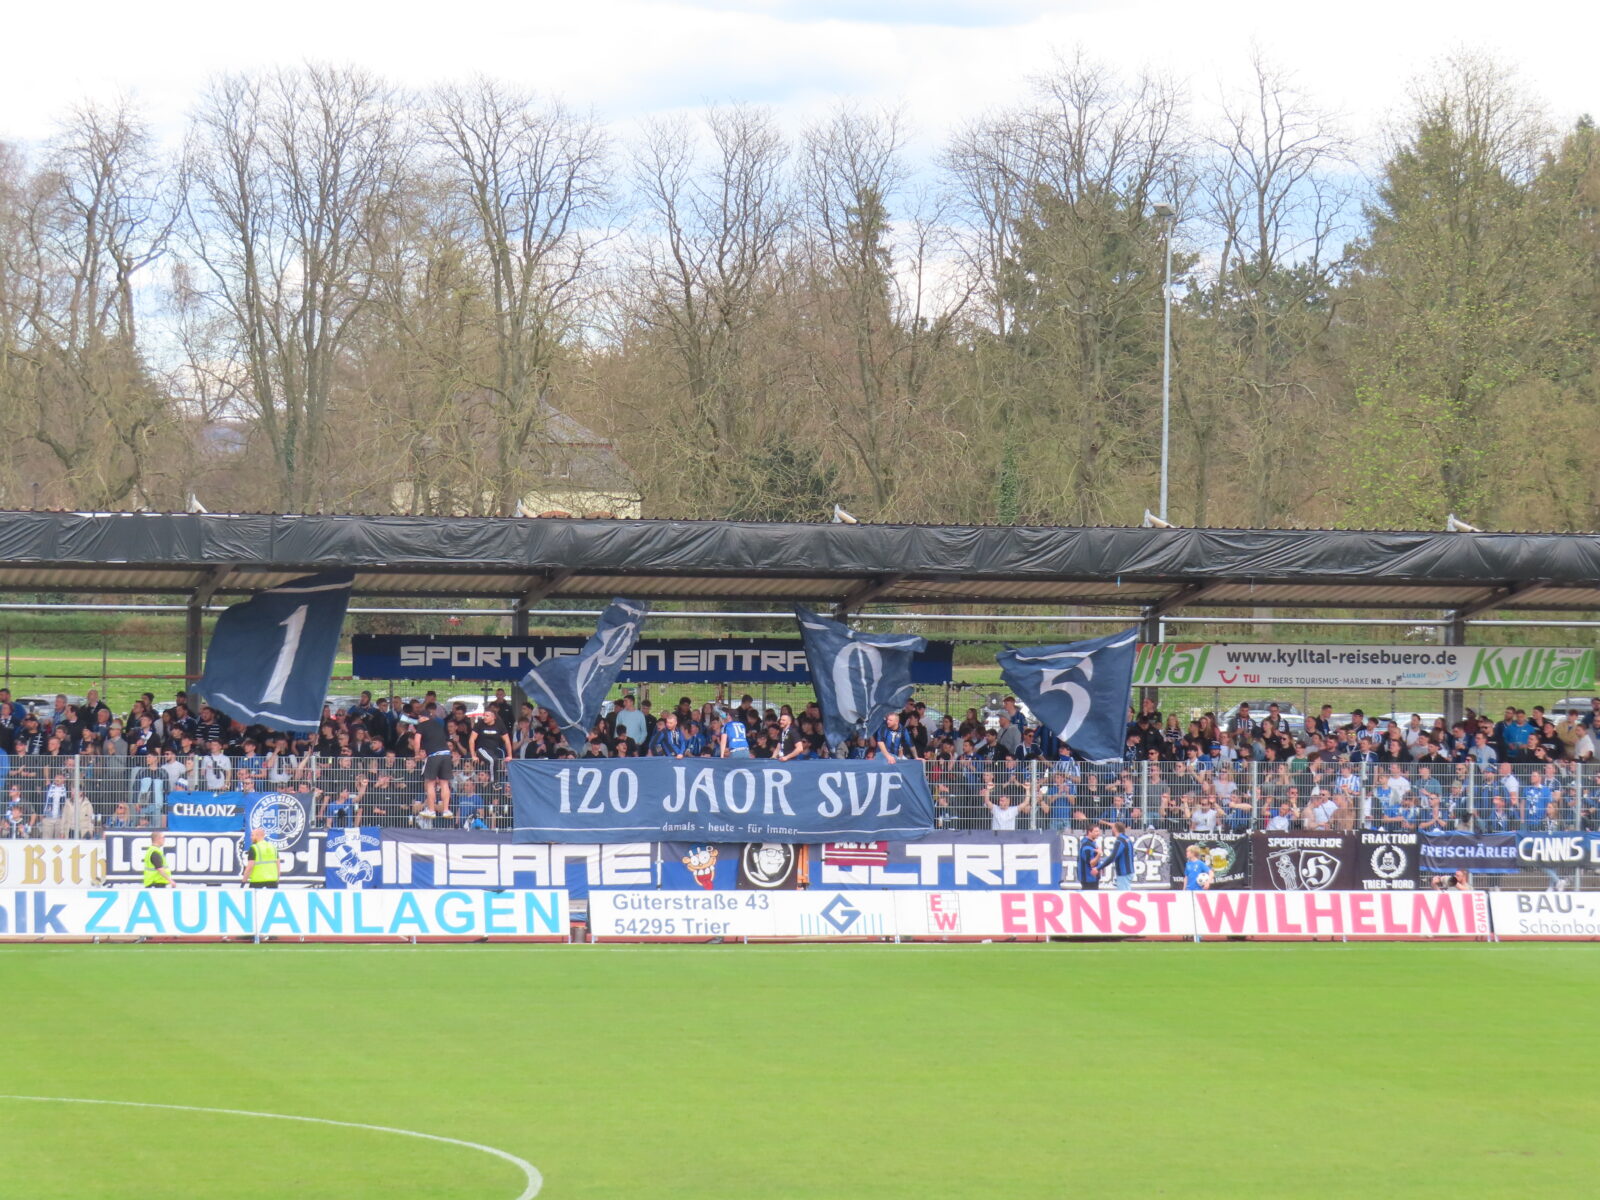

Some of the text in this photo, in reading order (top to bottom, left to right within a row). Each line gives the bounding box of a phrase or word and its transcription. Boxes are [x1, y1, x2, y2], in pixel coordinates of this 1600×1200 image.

[260, 604, 308, 704] 1
[401, 645, 666, 672] SPORTVIN
[1226, 649, 1457, 667] www.kylltal-reisebuero.de
[1468, 647, 1593, 689] Kylltal
[1243, 674, 1260, 683] TUI
[1268, 676, 1293, 685] TRIERS
[1295, 676, 1369, 685] TOURISMUS-MARKE
[1039, 656, 1093, 742] 5
[554, 765, 902, 818] 120 JAOR SVE
[260, 795, 297, 807] SEKTION
[172, 803, 236, 818] CHAONZ
[662, 822, 696, 832] damals
[708, 822, 734, 832] heute
[766, 824, 797, 835] immer
[1267, 837, 1343, 849] SPORTFREUNDE
[1361, 833, 1417, 845] FRAKTION
[1420, 843, 1517, 859] FREISCHÄRLER
[382, 841, 652, 887] INSANE
[1362, 879, 1415, 890] TRIER-NORD
[612, 892, 769, 911] Güterstraße 43
[85, 890, 561, 934] ZAUNANLAGEN
[1000, 892, 1489, 934] ERNST WILHELMI GMBH
[614, 918, 731, 935] 54295 Trier
